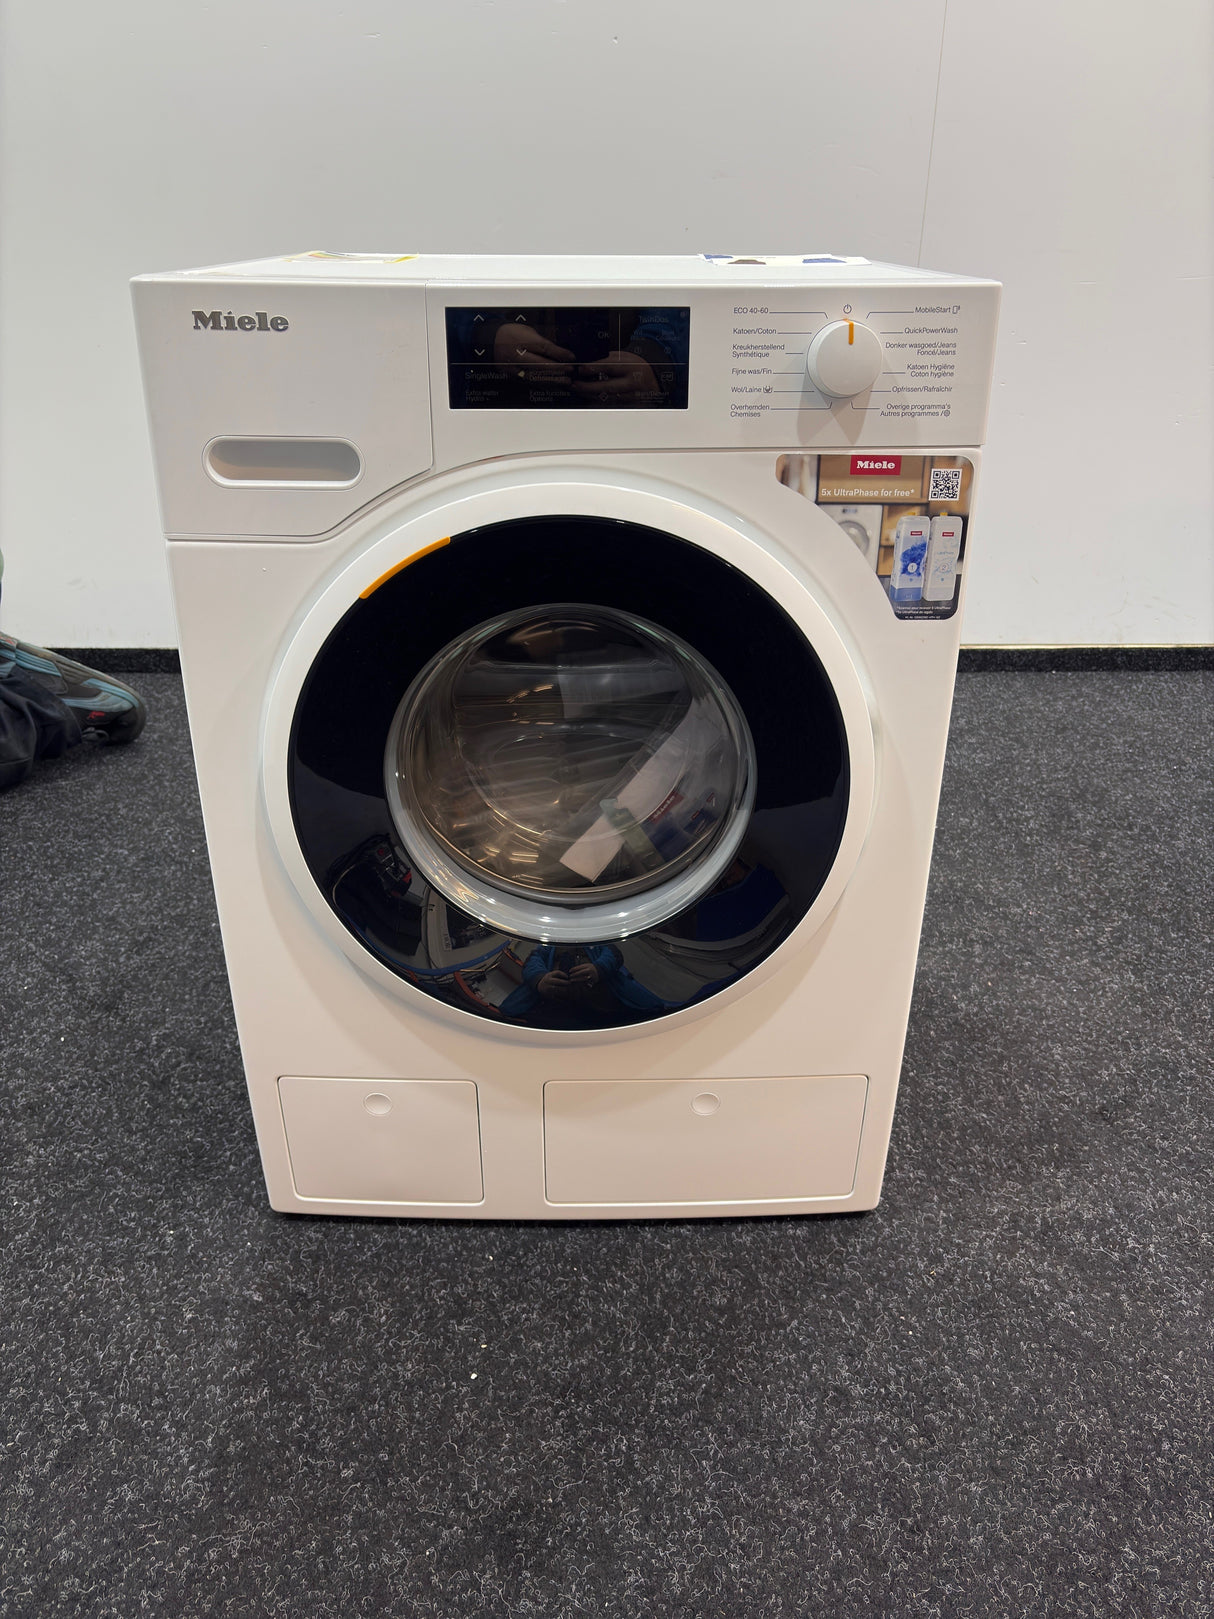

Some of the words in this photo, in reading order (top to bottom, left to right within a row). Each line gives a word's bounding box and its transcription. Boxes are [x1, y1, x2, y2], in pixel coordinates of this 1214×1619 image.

[192, 310, 289, 332] Miele
[732, 351, 770, 359] Synthétique
[732, 368, 747, 376] Fijne
[911, 403, 951, 411] programma's
[856, 460, 896, 470] Miele
[821, 488, 831, 497] 5x
[833, 488, 879, 497] UltraPhase
[880, 488, 893, 497] for
